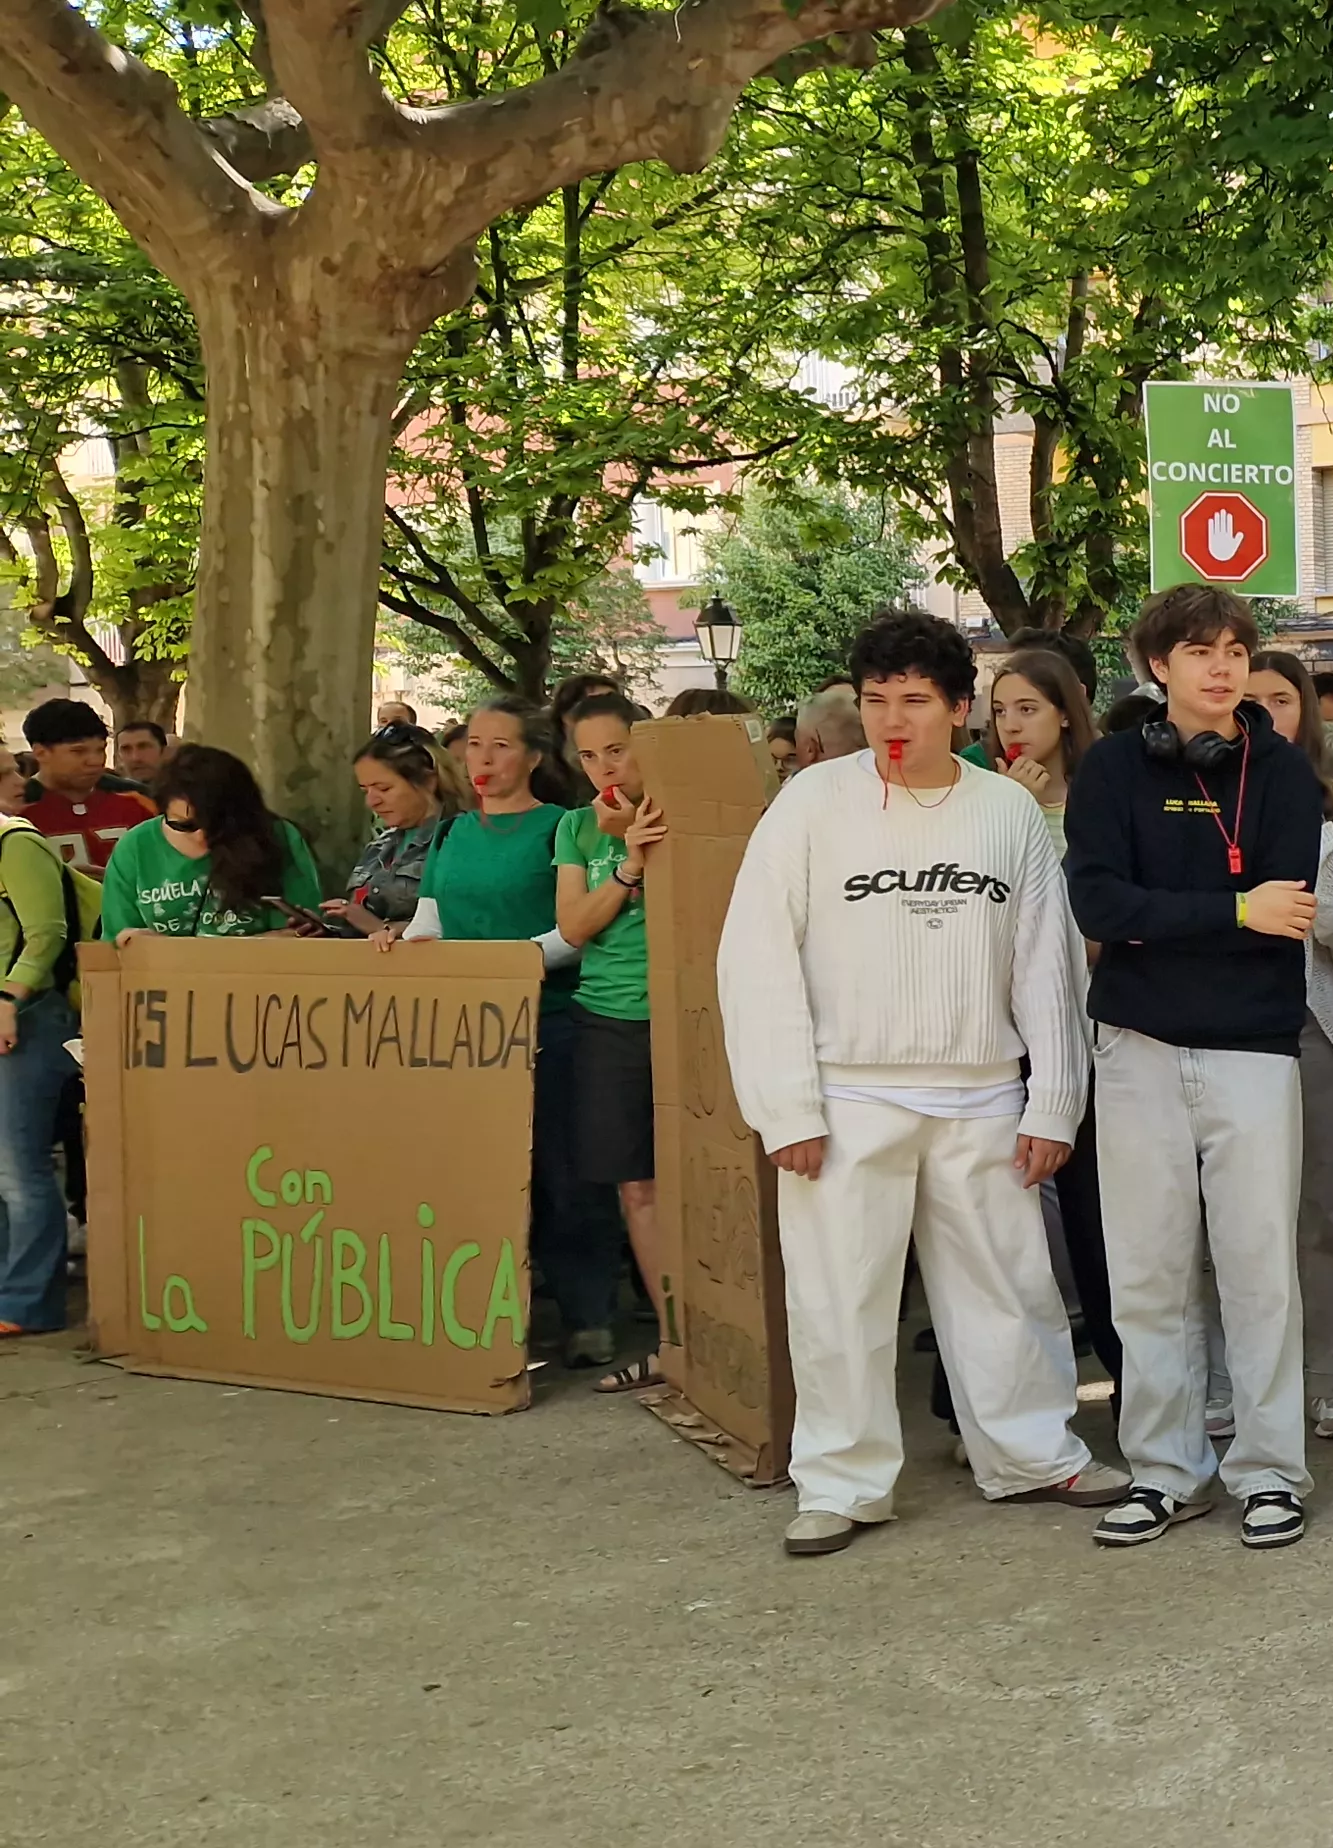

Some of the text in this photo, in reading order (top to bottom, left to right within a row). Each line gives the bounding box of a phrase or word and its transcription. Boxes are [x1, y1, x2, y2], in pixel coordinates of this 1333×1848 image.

[1203, 393, 1240, 414] NO
[1207, 428, 1237, 449] AL
[1151, 461, 1294, 485] CONCIERTO
[137, 878, 204, 906] SCUELA
[843, 862, 1012, 905] scuffers
[153, 918, 180, 934] DE
[124, 988, 534, 1074] IES LUCAS MALLADA
[246, 1142, 334, 1208] Con
[240, 1202, 526, 1350] PÚBLICA
